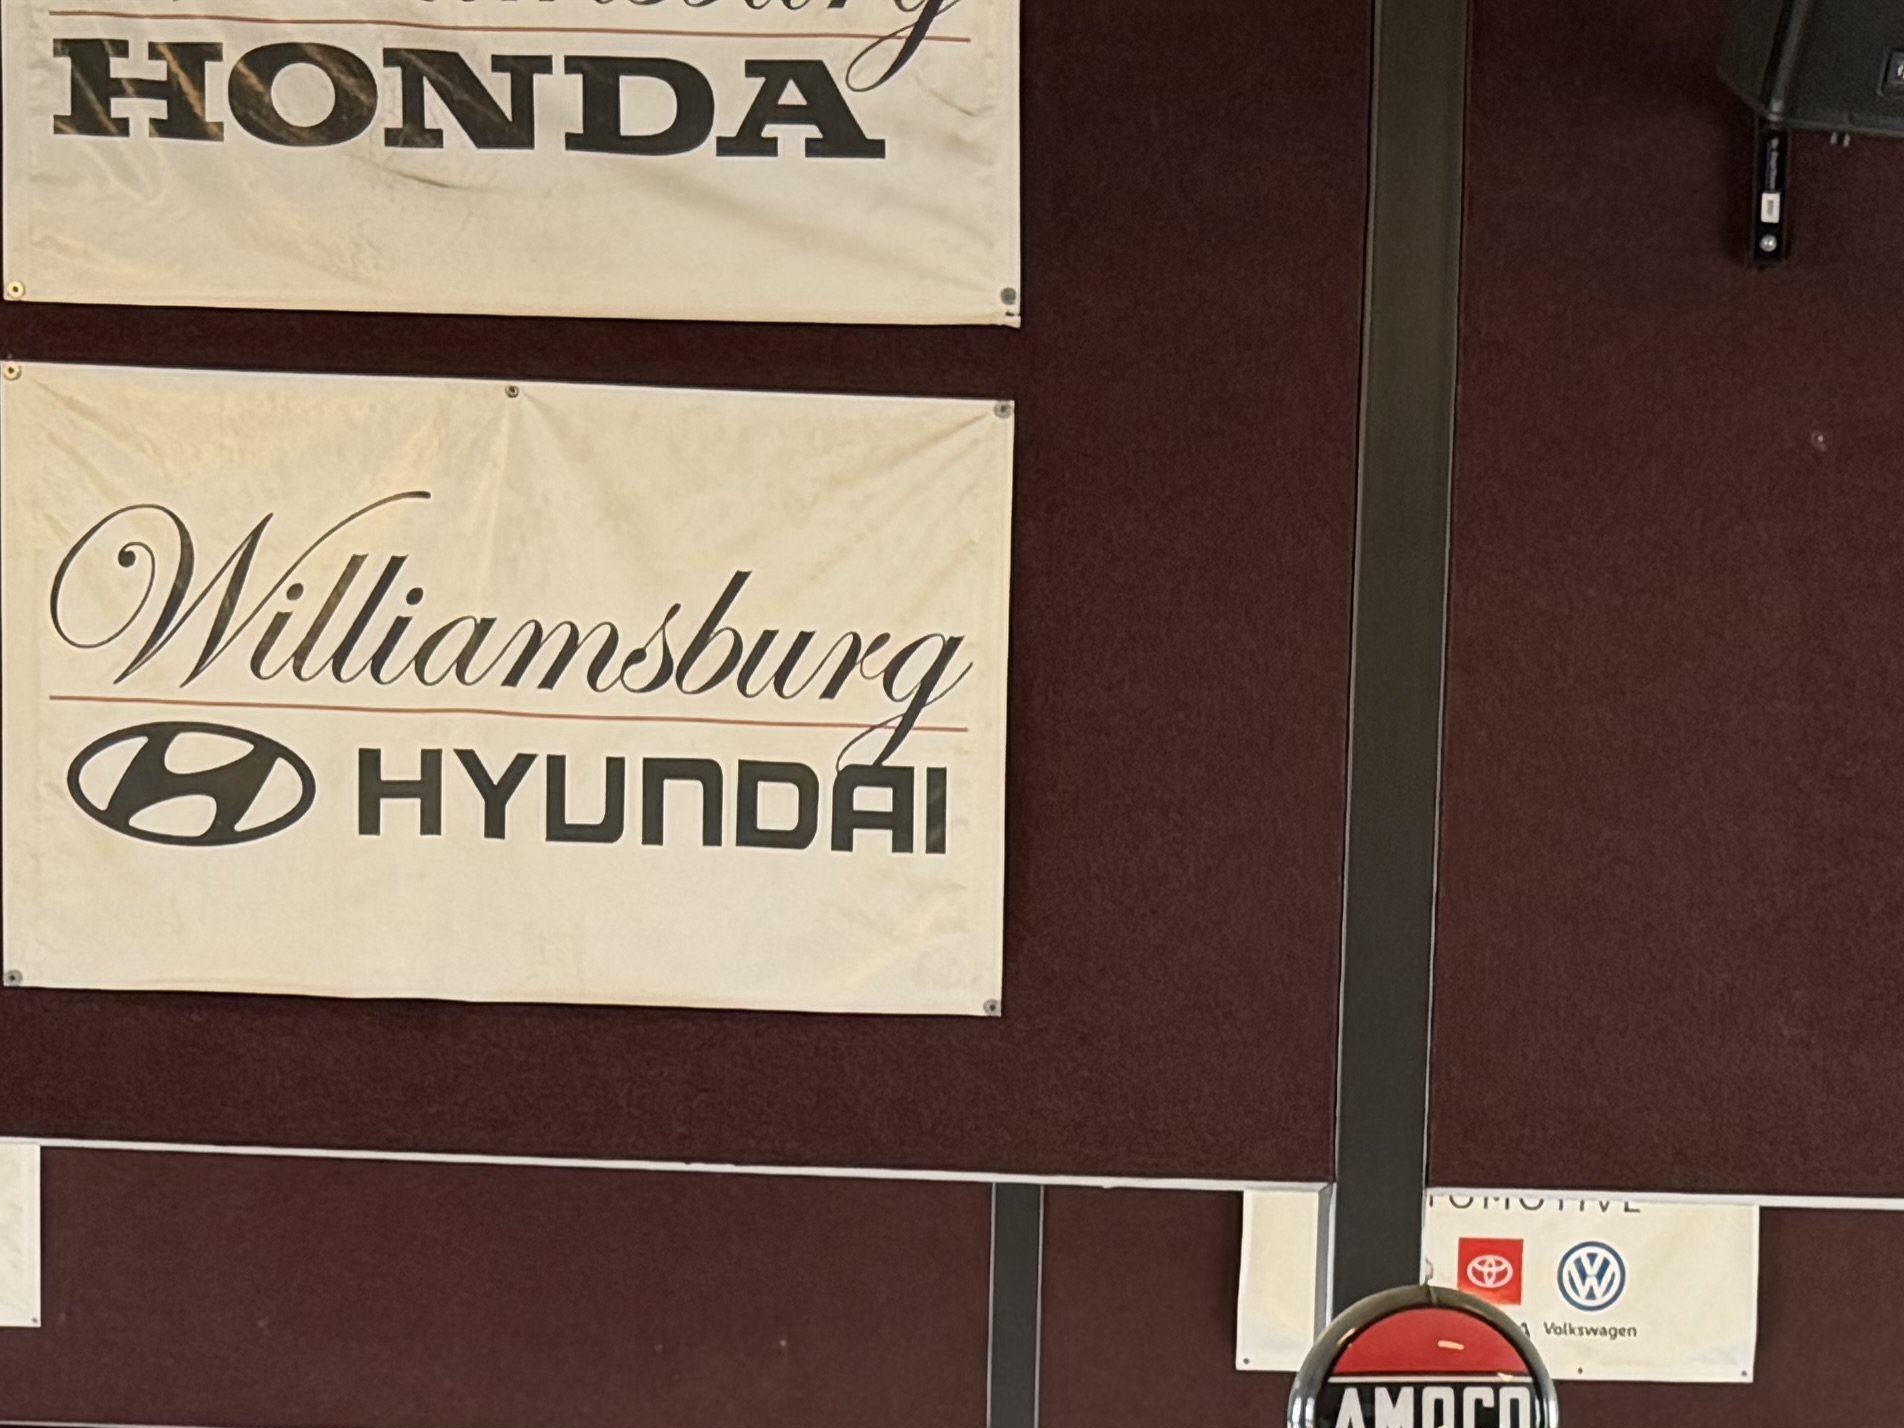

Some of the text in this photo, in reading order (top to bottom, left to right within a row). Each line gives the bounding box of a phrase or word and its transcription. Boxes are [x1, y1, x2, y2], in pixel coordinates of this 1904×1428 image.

[52, 37, 886, 158] HONDA
[50, 490, 971, 774] Williamsburg
[357, 748, 948, 854] HYUNDAI
[1544, 1322, 1637, 1340] Volkswagen
